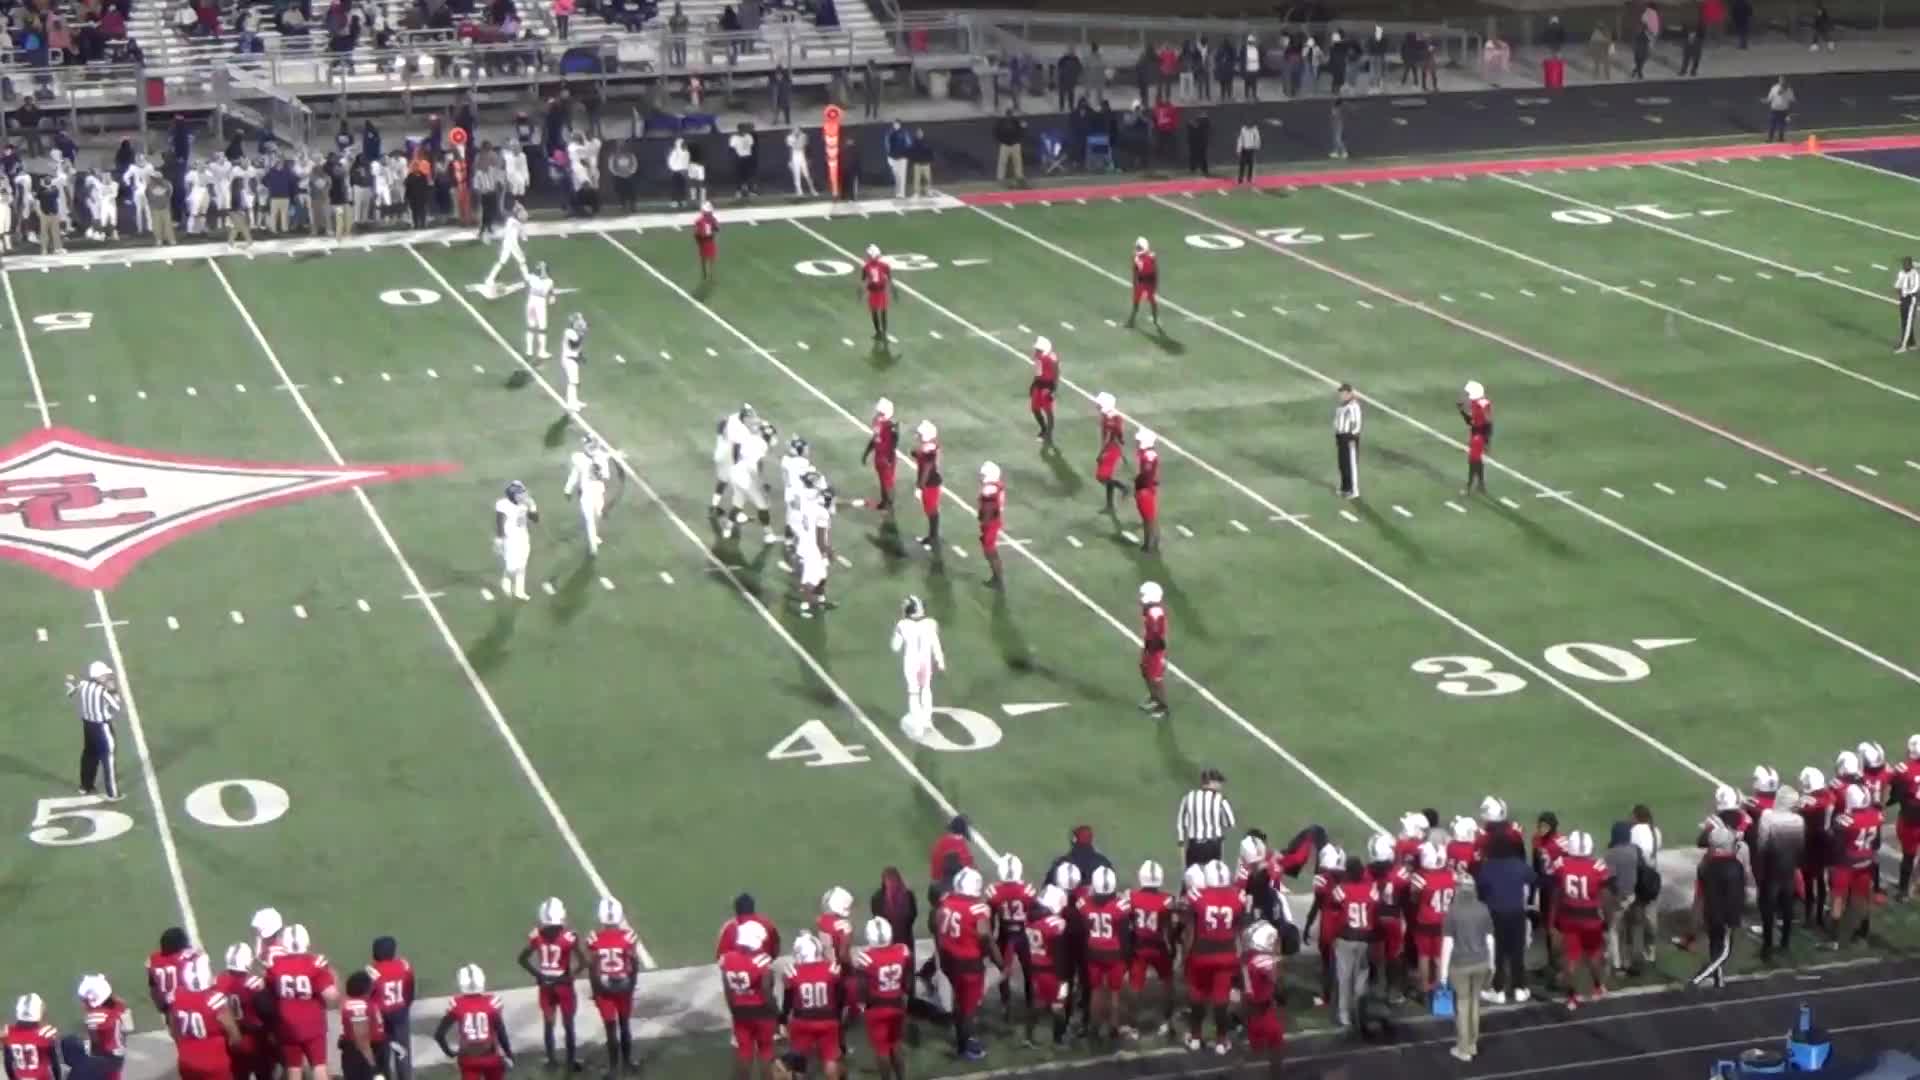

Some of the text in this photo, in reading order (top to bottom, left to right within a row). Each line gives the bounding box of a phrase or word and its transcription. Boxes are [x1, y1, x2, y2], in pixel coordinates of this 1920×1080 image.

[1551, 204, 1693, 224] 10
[1184, 228, 1324, 249] 20
[1410, 642, 1650, 696] 30
[768, 706, 1002, 766] 40
[30, 778, 289, 846] 50
[1566, 874, 1590, 900] 61
[1089, 912, 1113, 938] 35
[1349, 902, 1368, 928] 91
[384, 980, 405, 1005] 51
[801, 982, 828, 1008] 90
[178, 1011, 207, 1039] 70
[464, 1012, 489, 1040] 40
